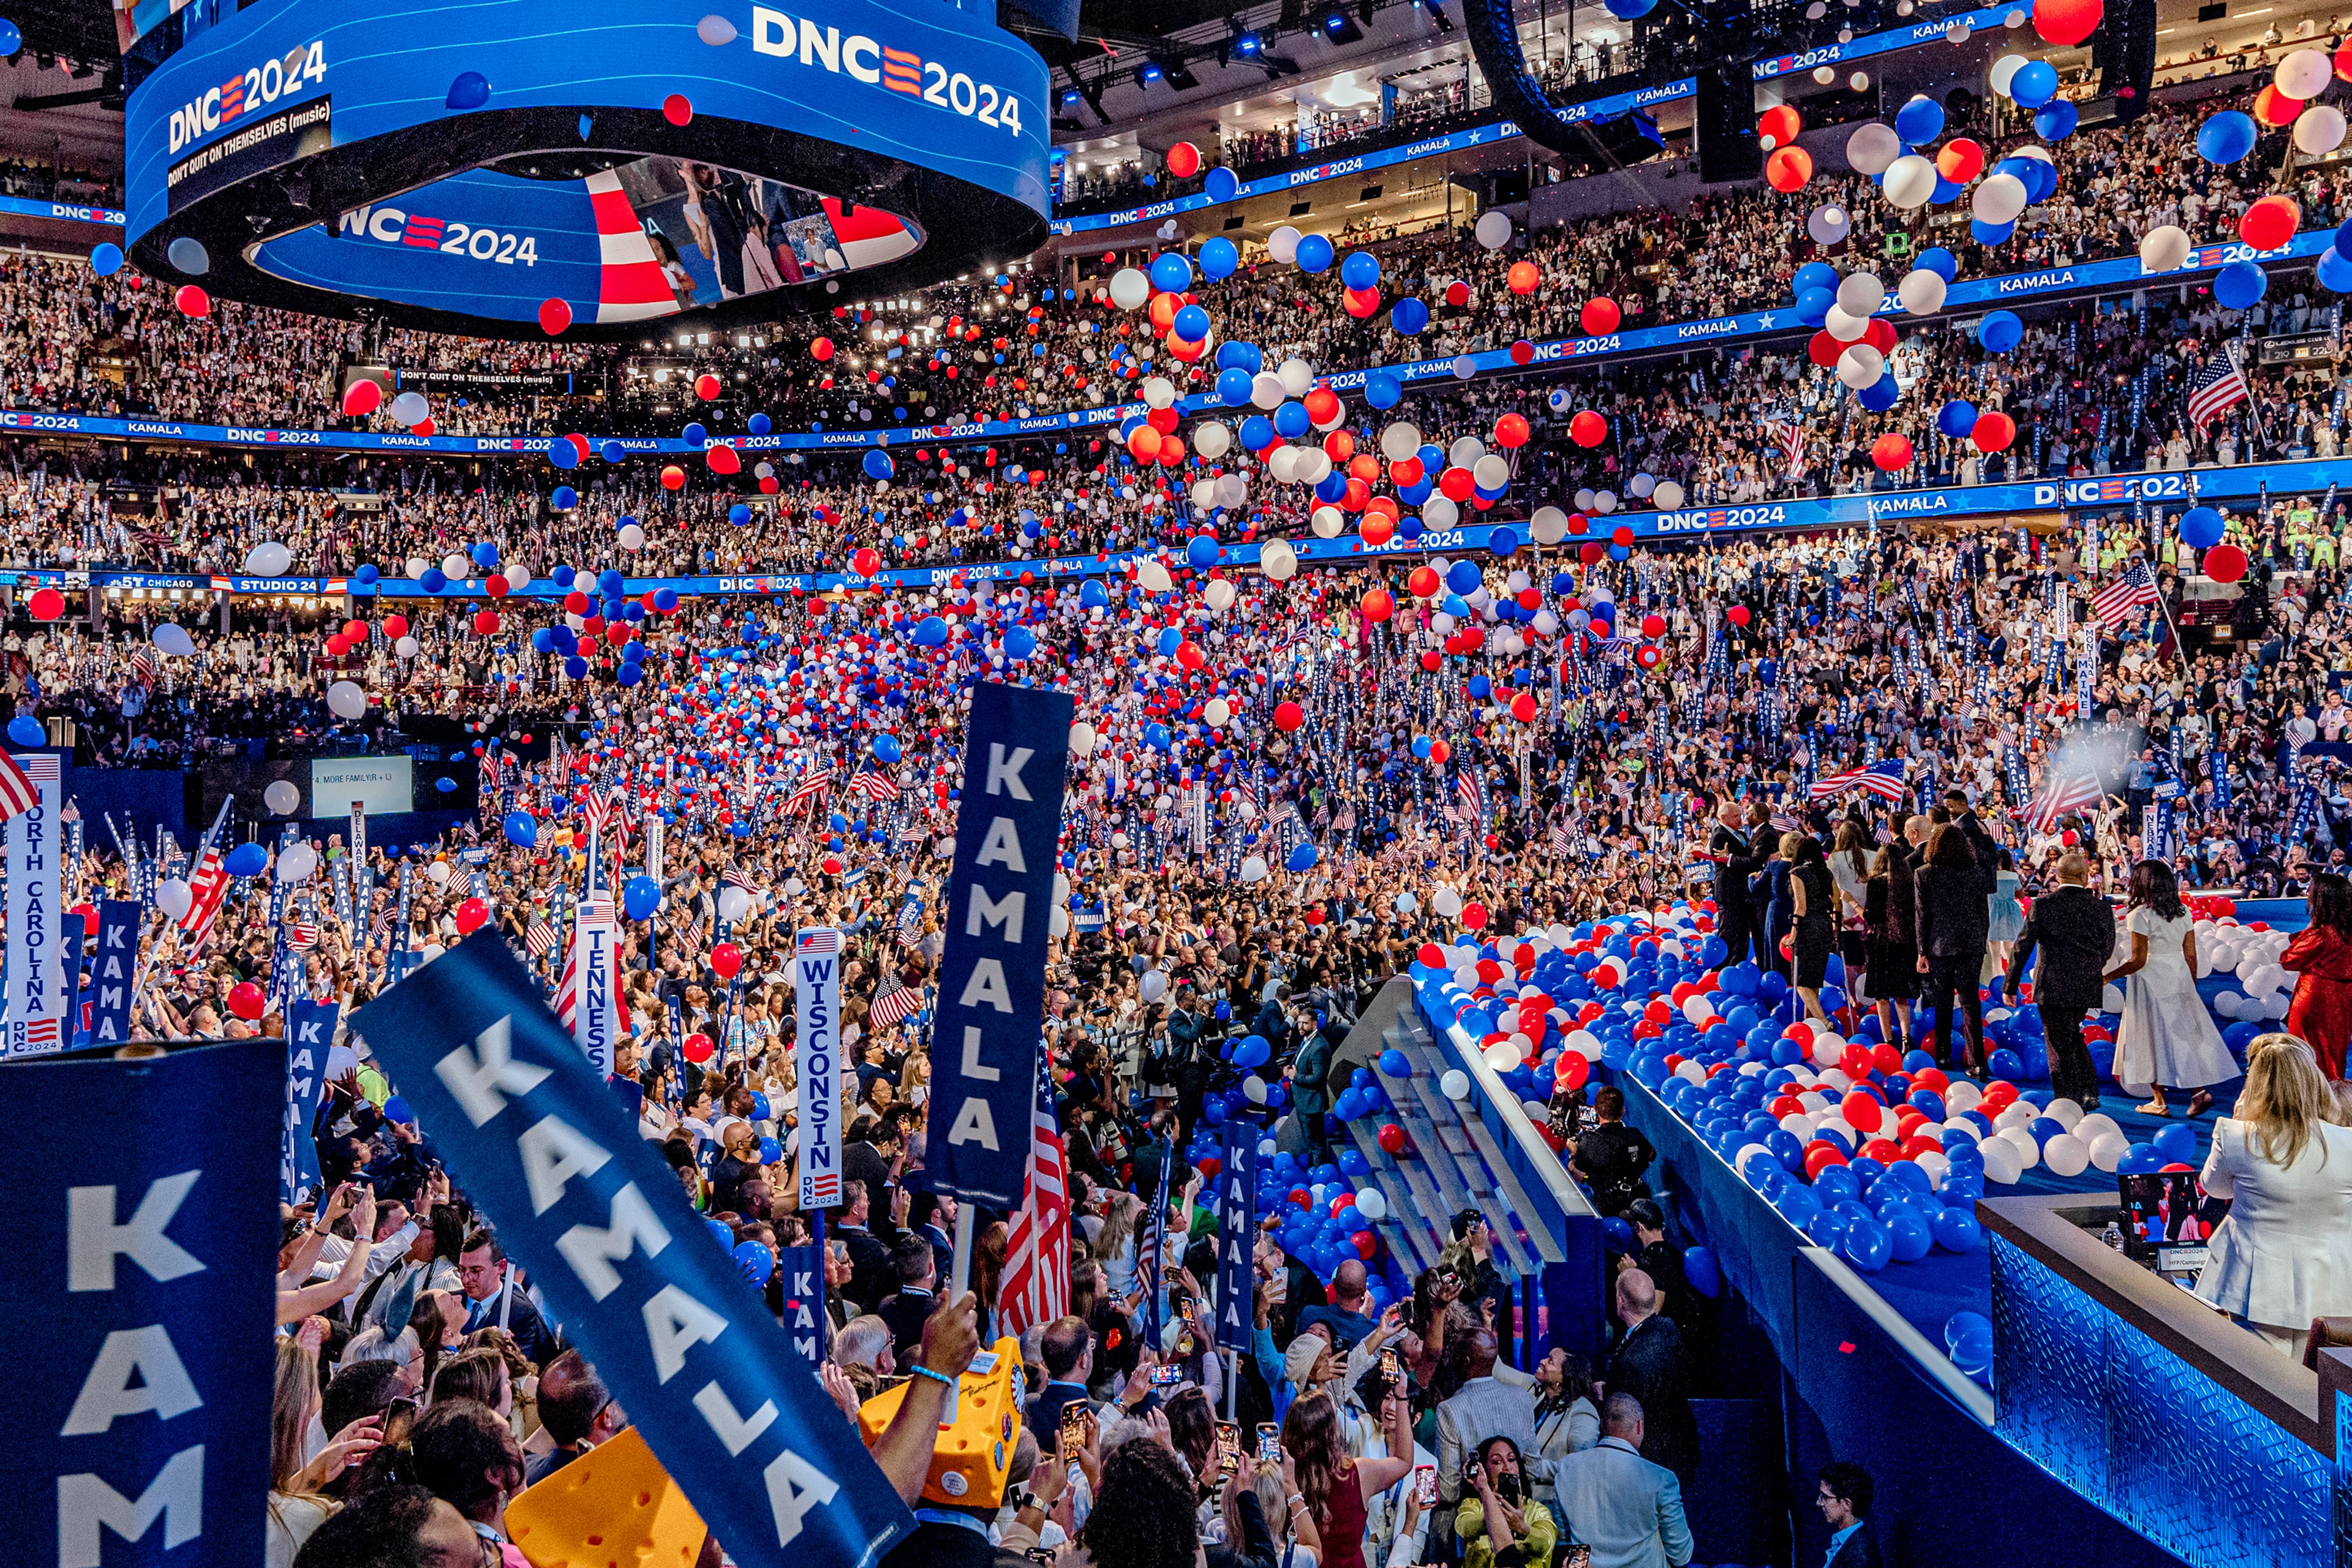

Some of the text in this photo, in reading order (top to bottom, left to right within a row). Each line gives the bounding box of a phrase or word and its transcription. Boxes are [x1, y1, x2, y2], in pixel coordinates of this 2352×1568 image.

[753, 6, 1022, 137] DNC 2024
[1752, 47, 1840, 78] NC 2024
[170, 40, 326, 154] DNC 2024
[1637, 83, 1687, 102] KAMALA
[168, 102, 330, 187] DON'T QUIT ON THEMSELVES (music)
[1408, 138, 1450, 156] KAMALA
[1291, 158, 1362, 184] DNC 2024
[53, 205, 126, 224] DNC 20
[1110, 202, 1174, 224] DNC 2024
[339, 206, 538, 266] NC 2024
[2000, 271, 2073, 292] KAMALA
[1679, 320, 1738, 337] KAMALA
[1577, 336, 1621, 353] 2024
[524, 375, 552, 384] (music)
[1330, 372, 1366, 388] 2024
[33, 416, 79, 429] 2024
[129, 423, 182, 434] KAMALA
[951, 424, 984, 436] 2024
[1020, 418, 1058, 429] KAMALA
[1089, 409, 1115, 422] DNC
[228, 429, 320, 443] DNC 2024
[382, 437, 430, 446] KAMALA
[478, 439, 551, 450] DNC 202
[704, 437, 780, 450] DNC 2024
[824, 434, 865, 443] KAMALA
[1869, 496, 1947, 513] KAMALA
[2035, 475, 2201, 505] DNC 2024
[1658, 507, 1785, 531] DNC 2024
[1419, 531, 1464, 548] 2024
[1042, 561, 1082, 573] KMALA
[241, 581, 316, 590] STUDIO 24
[776, 577, 801, 589] 024
[1907, 583, 1918, 612] KAMALA
[1962, 598, 1971, 624] KAMALA
[1708, 642, 1721, 673] KAMALA
[1910, 634, 1918, 667] KAMALA
[2047, 645, 2059, 680] KAMALA
[1894, 650, 1905, 685] KAMALA
[1975, 670, 1985, 703] KAMALA
[2079, 660, 2087, 709] MAINE
[1322, 758, 1335, 791] KAMALA
[1564, 764, 1575, 799] KAMALA
[2007, 748, 2018, 788] KAMALA
[2215, 758, 2225, 801] KAMALA
[1385, 783, 1393, 809] KAMALA
[1476, 769, 1489, 804] KAMALA
[2155, 782, 2179, 793] HARRIS
[1291, 805, 1308, 840] KAMALA
[1436, 799, 1446, 840] KAMALA
[2291, 792, 2312, 837] KAMALA
[2157, 809, 2166, 851] KAMALA
[464, 850, 486, 859] HARRIS
[1232, 832, 1241, 873] KAMALA
[1687, 864, 1710, 874] HARRIS
[26, 786, 44, 1013] ORTH CAROLINA
[336, 864, 349, 914] KAMALA
[401, 869, 410, 919] KAMALA
[948, 743, 1035, 1152] KAMALA
[587, 930, 605, 1070] TENNESS
[13, 1022, 25, 1052] DNC
[28, 1042, 58, 1052] 2024
[670, 1007, 684, 1093] KAMALA
[802, 960, 832, 1169] WISCONSIN
[804, 1177, 812, 1205] DNC
[1225, 1147, 1245, 1327] KAMALA
[434, 1014, 840, 1548] KAMALA
[794, 1272, 818, 1360] KAM
